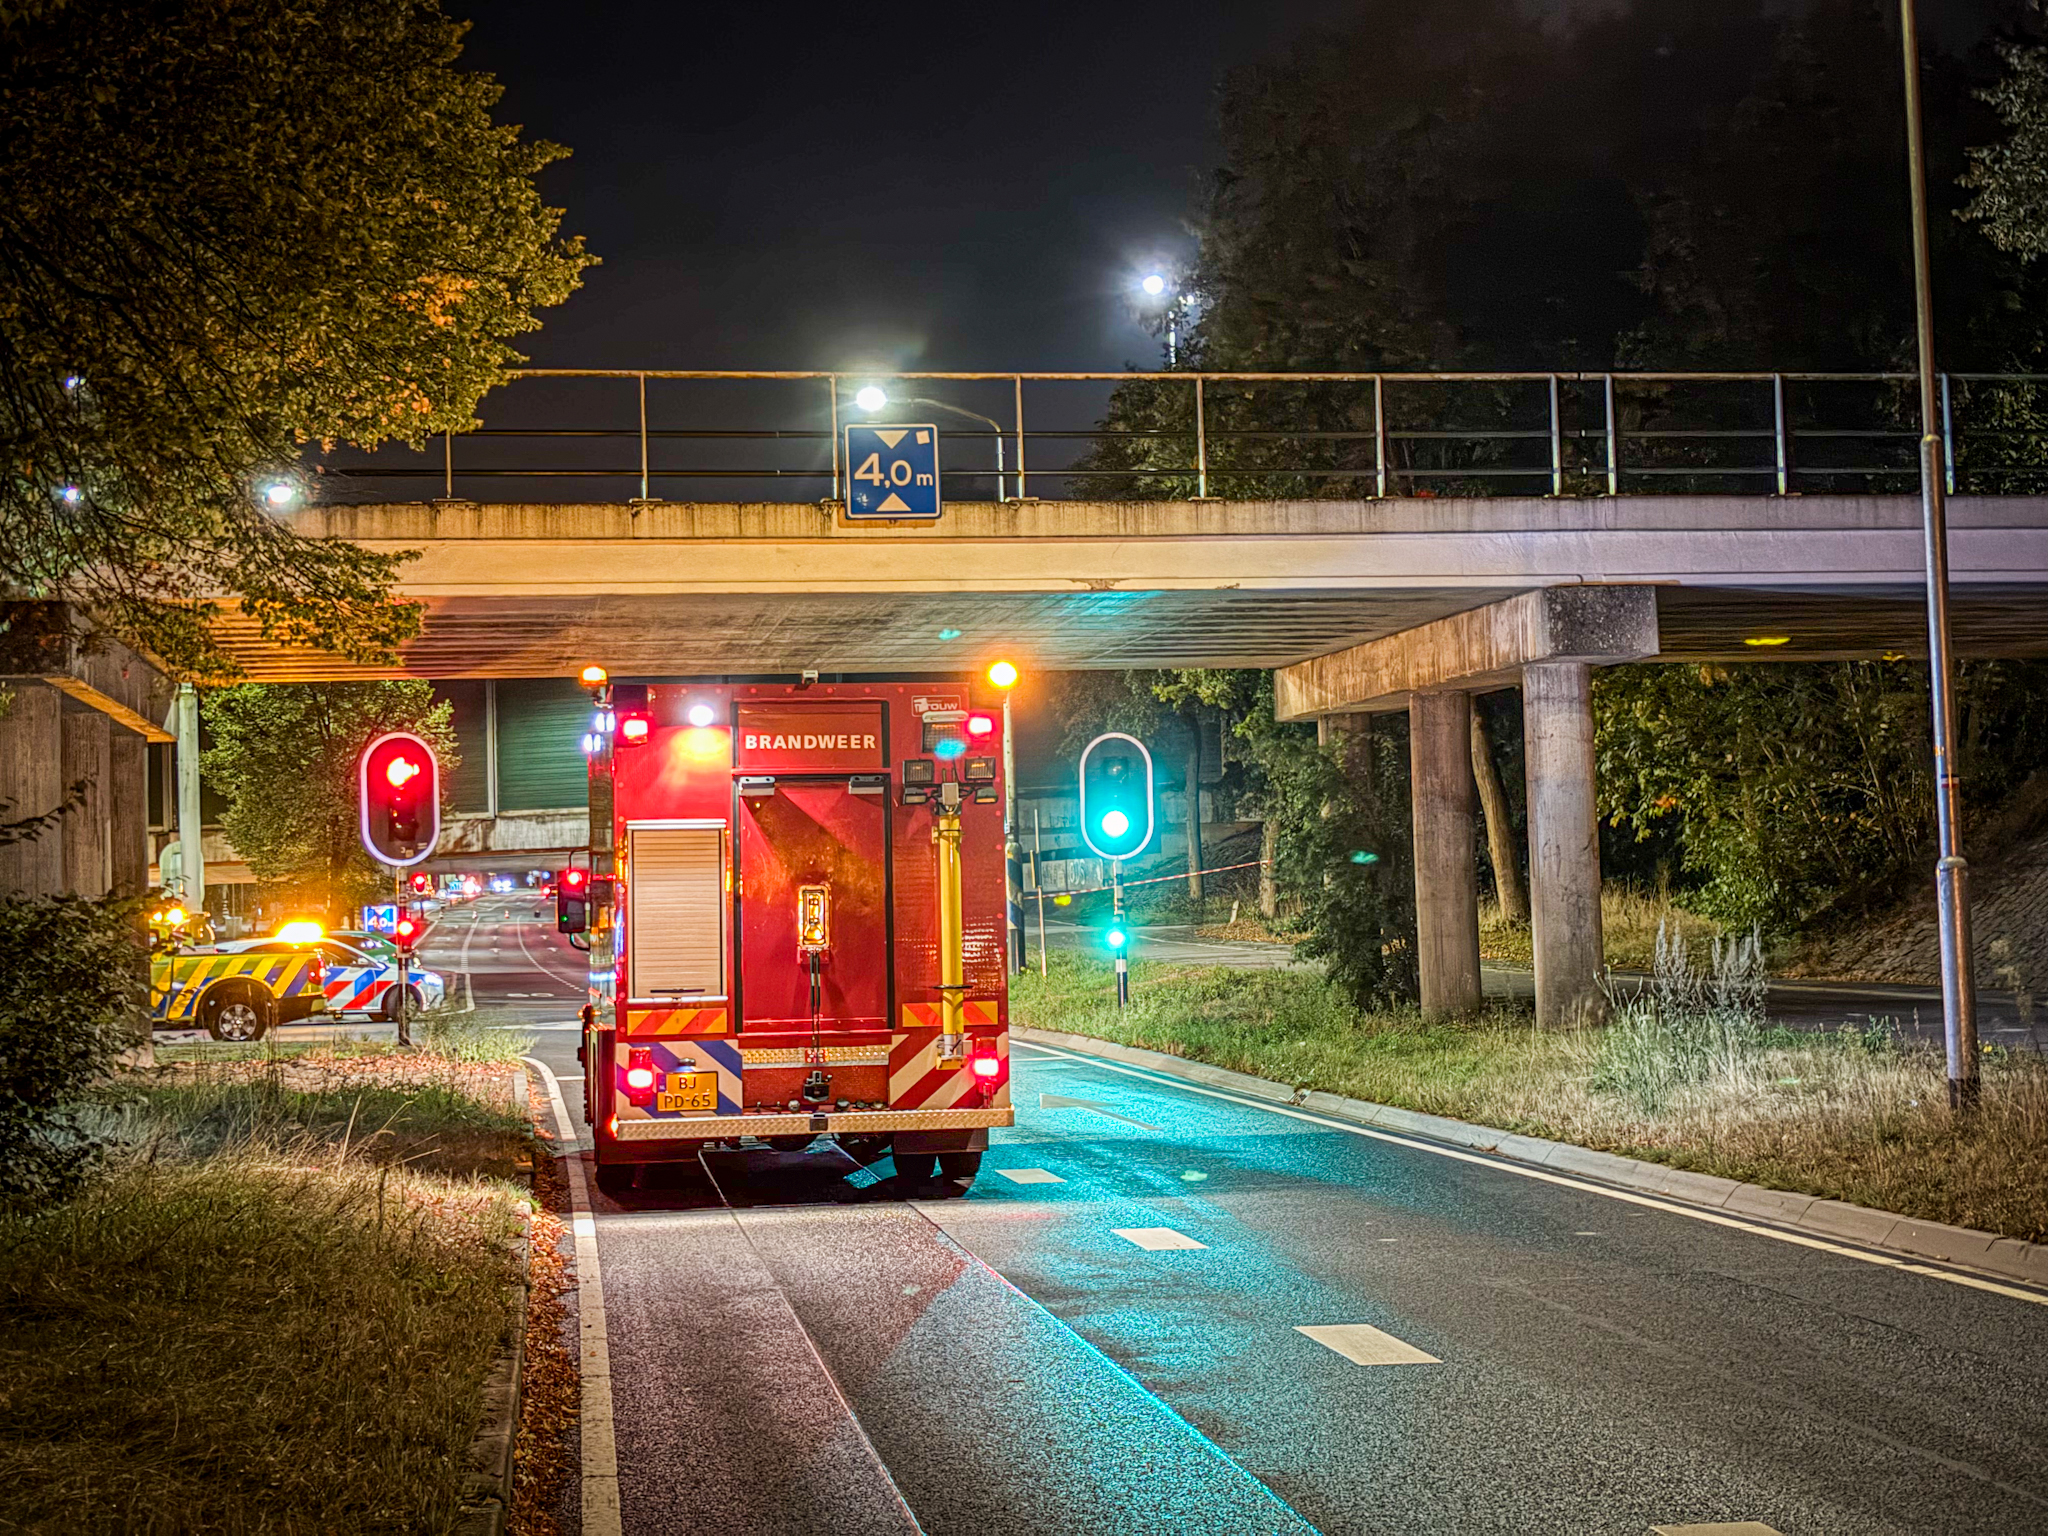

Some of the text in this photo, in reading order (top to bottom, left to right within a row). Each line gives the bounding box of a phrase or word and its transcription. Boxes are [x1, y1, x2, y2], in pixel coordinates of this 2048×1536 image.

[854, 453, 934, 489] 4,0 m
[745, 734, 876, 750] BRANDWEER
[679, 1077, 697, 1090] BJ
[664, 1093, 711, 1109] PD-65
